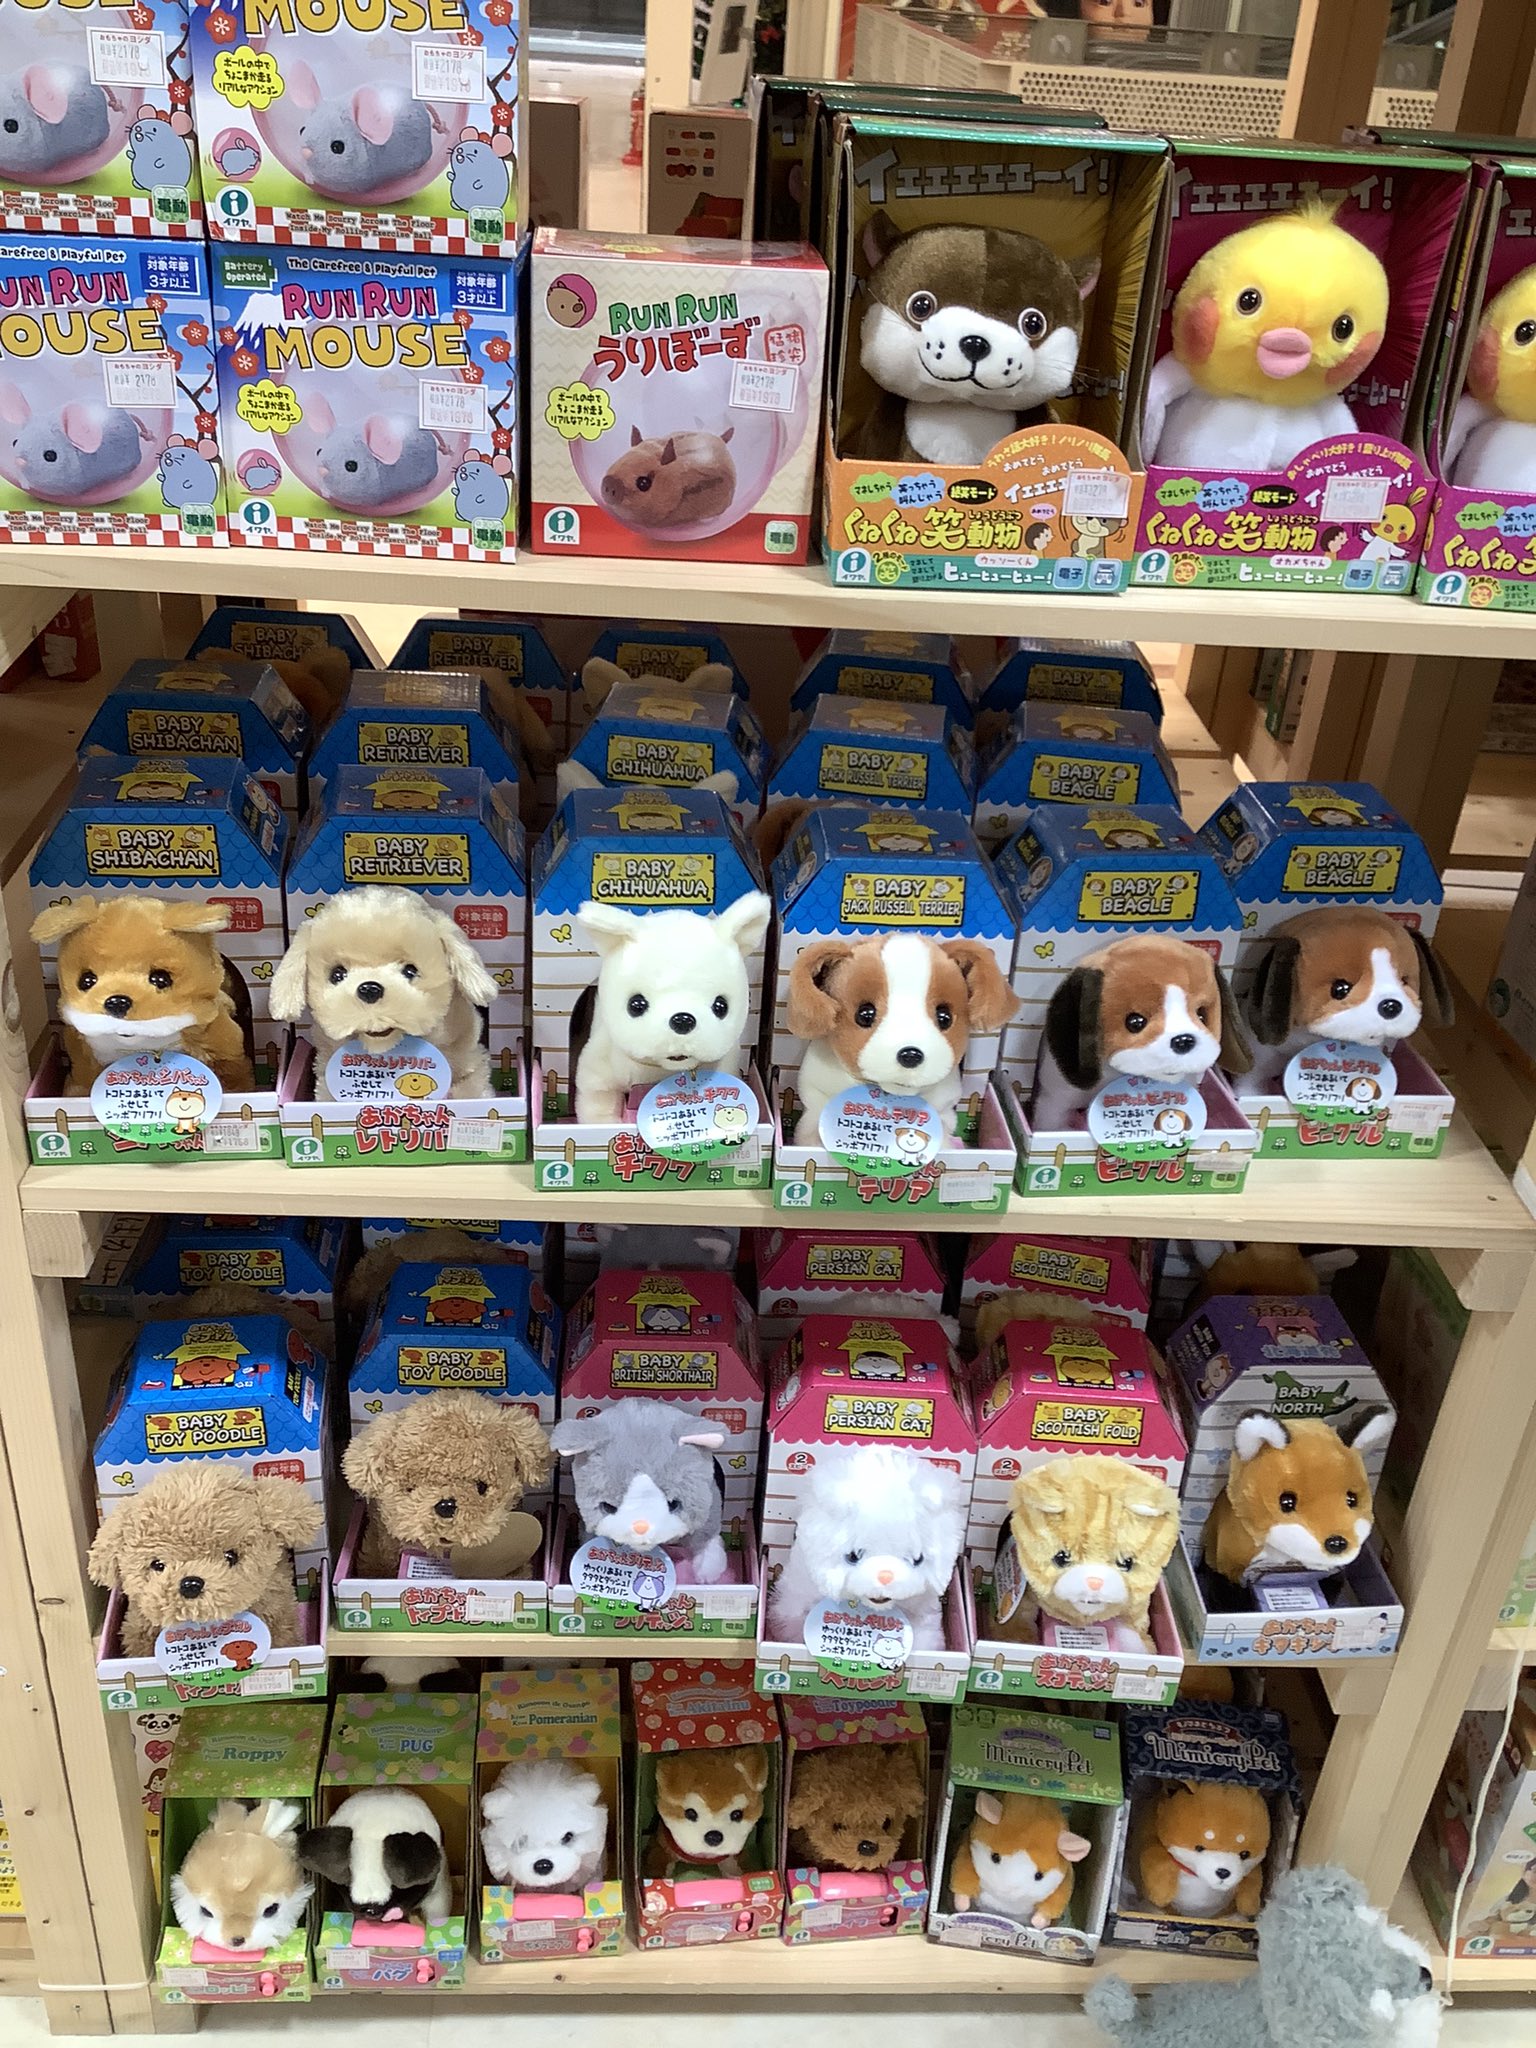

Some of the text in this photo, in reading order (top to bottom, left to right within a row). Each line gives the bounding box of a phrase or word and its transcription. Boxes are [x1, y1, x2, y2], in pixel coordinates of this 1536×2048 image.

[100, 35, 151, 44] おもちゃのヨシダ
[224, 58, 270, 70] ボールの中で
[224, 70, 272, 83] ちょこまか走る
[219, 82, 278, 96] リアルなアクション
[157, 198, 187, 213] 電動
[285, 212, 311, 222] Watch
[313, 213, 324, 222] Me
[360, 217, 389, 226] Across
[392, 218, 407, 228] The
[411, 220, 436, 229] Floor
[474, 219, 500, 234] 電動
[290, 224, 317, 234] Inside
[335, 227, 369, 237] Rolling
[372, 229, 410, 239] Exercise
[413, 230, 433, 240] Ball
[0, 246, 125, 262] arefree & Playful Pet
[147, 260, 189, 271] 対象年齢
[224, 261, 263, 272] Battery
[288, 258, 436, 277] The Carefree & Playful Pet
[150, 275, 190, 288] 3才以上
[226, 272, 267, 282] Operated
[457, 276, 497, 288] 対象年齢
[0, 267, 130, 308] UN RUN
[283, 281, 437, 321] RUN RUN
[458, 290, 497, 306] 3才以上
[608, 292, 740, 335] RUN RUN
[0, 308, 165, 357] OUSE
[265, 325, 469, 371] MOUSE
[593, 316, 761, 382] うりぼーず
[246, 389, 290, 399] ボールの中で
[557, 392, 602, 403] ボールの中で
[247, 400, 291, 411] ちょこまか走る
[556, 404, 603, 416] ちょこまか走る
[242, 410, 297, 421] リアルなアクション
[550, 415, 608, 427] リアルなアクション
[477, 528, 502, 543] 電動
[843, 507, 1022, 549] くねくね笑動物
[1146, 510, 1318, 552] くねくね笑動物
[769, 531, 795, 546] 電動
[1059, 569, 1082, 579] 電子
[1350, 569, 1373, 581] 電子
[255, 627, 296, 642] BABY
[155, 716, 203, 731] BABY
[132, 733, 239, 751] SHIBACHAN
[386, 727, 433, 745] BABY
[363, 745, 463, 764] RETRIEVER
[636, 743, 679, 760] BABY
[848, 752, 894, 771] BABY
[611, 760, 708, 781] CHIHUAHUA
[1059, 764, 1104, 782] BABY
[822, 768, 924, 791] JACK RUSSELL TERRIER
[1050, 780, 1115, 800] BEAGLE
[118, 830, 174, 848] BABY
[375, 837, 429, 855] BABY
[91, 850, 214, 868] SHIBACHAN
[349, 856, 463, 877] RETRIEVER
[1315, 852, 1366, 870] BABY
[625, 859, 675, 877] BABY
[1304, 868, 1375, 887] BEAGLE
[597, 878, 708, 898] CHIHUAHUA
[874, 879, 926, 897] BABY
[1111, 877, 1162, 897] BABY
[843, 900, 961, 918] JACK RUSSELL TERRIER
[1101, 895, 1172, 915] BEAGLE
[340, 1070, 396, 1079] トコトコあるいて
[352, 1080, 382, 1089] ふせして
[105, 1090, 164, 1099] トコトコあるいて
[339, 1090, 394, 1100] シッポフリフリ
[118, 1100, 149, 1109] ふせして
[105, 1110, 162, 1120] シッポフリフリ
[360, 1105, 450, 1127] あかちゃん
[1103, 1109, 1155, 1118] トコトコあるいて
[837, 1119, 892, 1132] トコトコあるいて
[848, 1131, 877, 1142] ふせして
[1300, 1122, 1385, 1145] ビーグル
[836, 1141, 889, 1153] シッポフリフリ
[614, 1153, 695, 1181] チワワ
[1097, 1158, 1185, 1182] ビーグル
[858, 1178, 933, 1202] テリア
[207, 1253, 250, 1266] BABY
[832, 1250, 871, 1261] BABY
[1039, 1251, 1079, 1268] BABY
[183, 1266, 281, 1281] TOY POODLE
[810, 1263, 900, 1275] PERSIAN CAT
[1014, 1262, 1106, 1287] SCOTTISH FOLD
[428, 1352, 473, 1364] BABY
[639, 1355, 683, 1367] BABY
[402, 1367, 503, 1380] TOY POODLE
[614, 1369, 713, 1382] BRITISH SHORTHAIR
[1279, 1386, 1322, 1398] BABY
[853, 1400, 898, 1414] BABY
[1063, 1407, 1108, 1422] BABY
[1271, 1402, 1324, 1415] NORTH
[177, 1415, 226, 1428] BABY
[829, 1415, 930, 1431] PERSIAN CAT
[150, 1427, 261, 1446] TOY POODLE
[1036, 1421, 1138, 1439] SCOTTISH FOLD
[584, 1563, 632, 1578] ゆっくりあるいて
[1040, 1653, 1115, 1672] あかちゃん
[529, 1713, 598, 1725] Pomeranian
[401, 1740, 433, 1752] PUG
[1145, 1733, 1281, 1772] Mimicry Pet
[223, 1748, 287, 1762] Roppy
[982, 1742, 1093, 1776] Mimicry Pet
[373, 1969, 413, 1981] パグ
